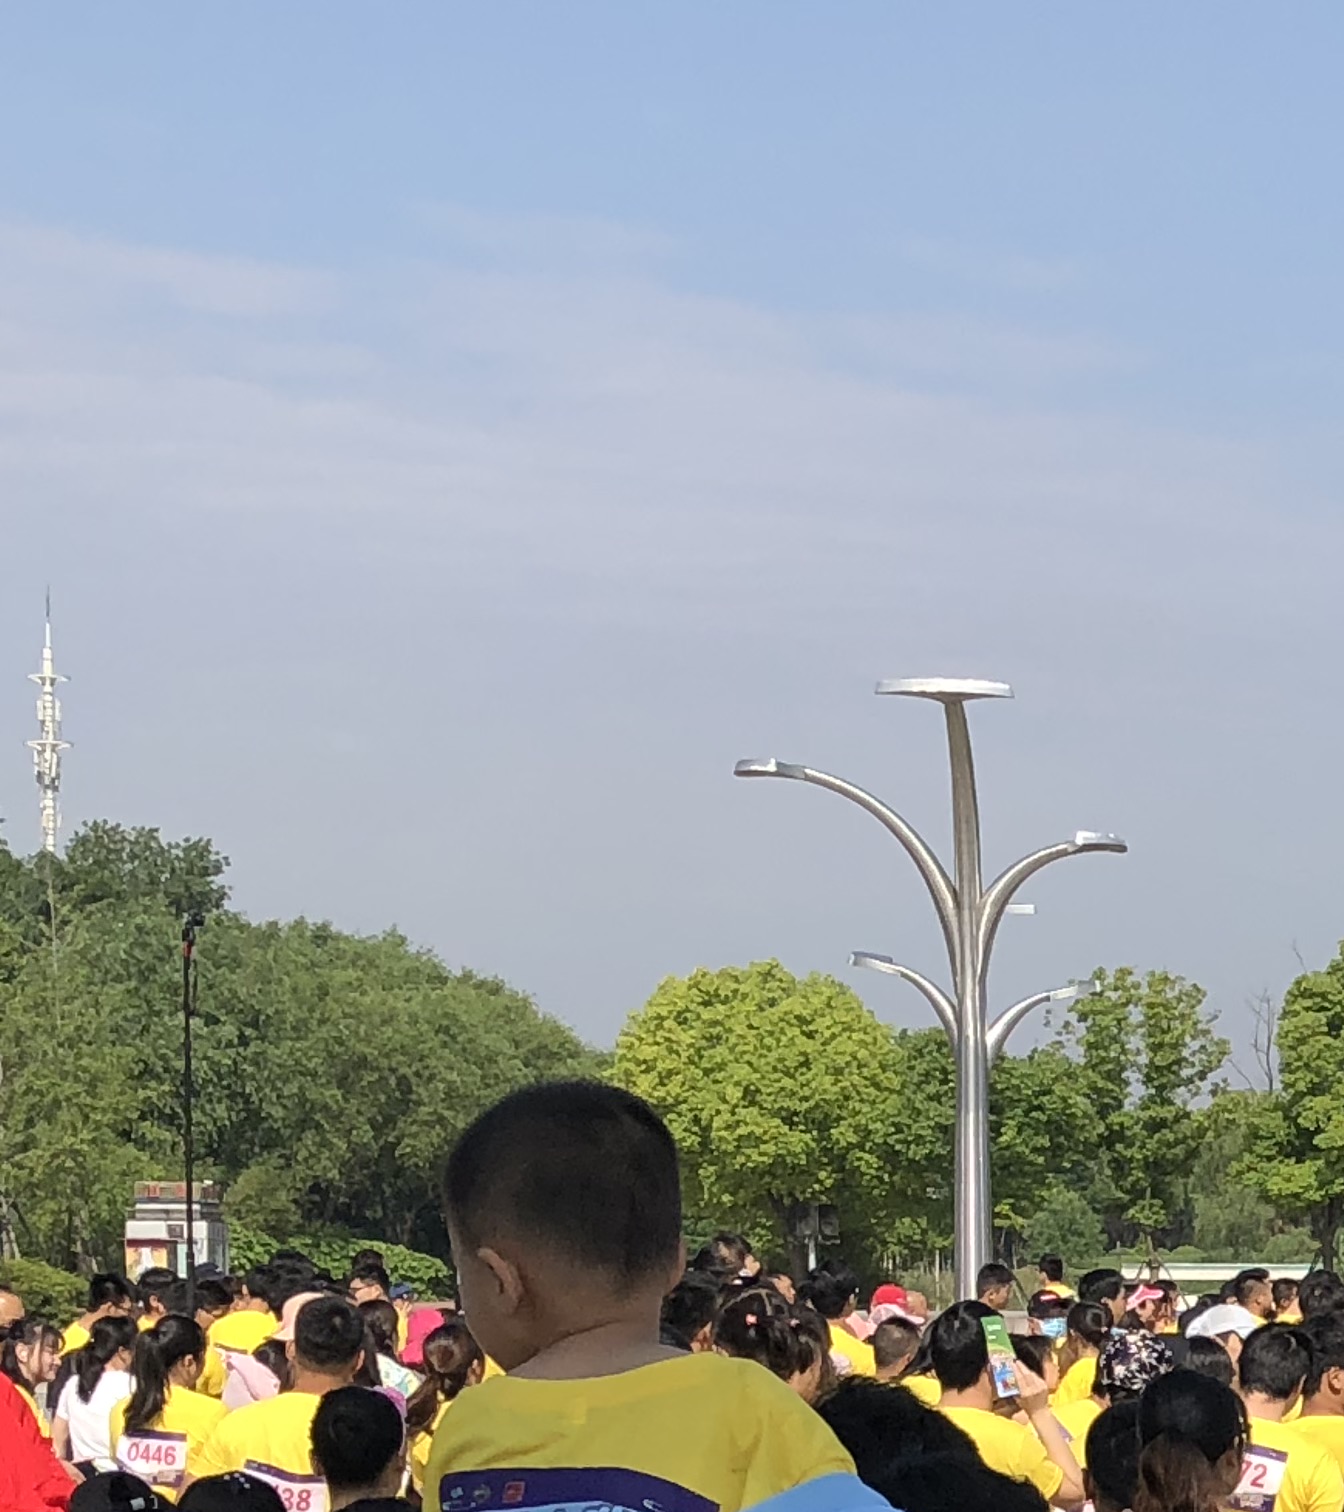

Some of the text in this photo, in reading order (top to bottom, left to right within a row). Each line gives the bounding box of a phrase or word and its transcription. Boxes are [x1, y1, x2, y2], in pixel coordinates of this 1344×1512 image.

[126, 1442, 177, 1466] 0446
[1240, 1460, 1268, 1490] 72
[275, 1485, 312, 1512] 38
